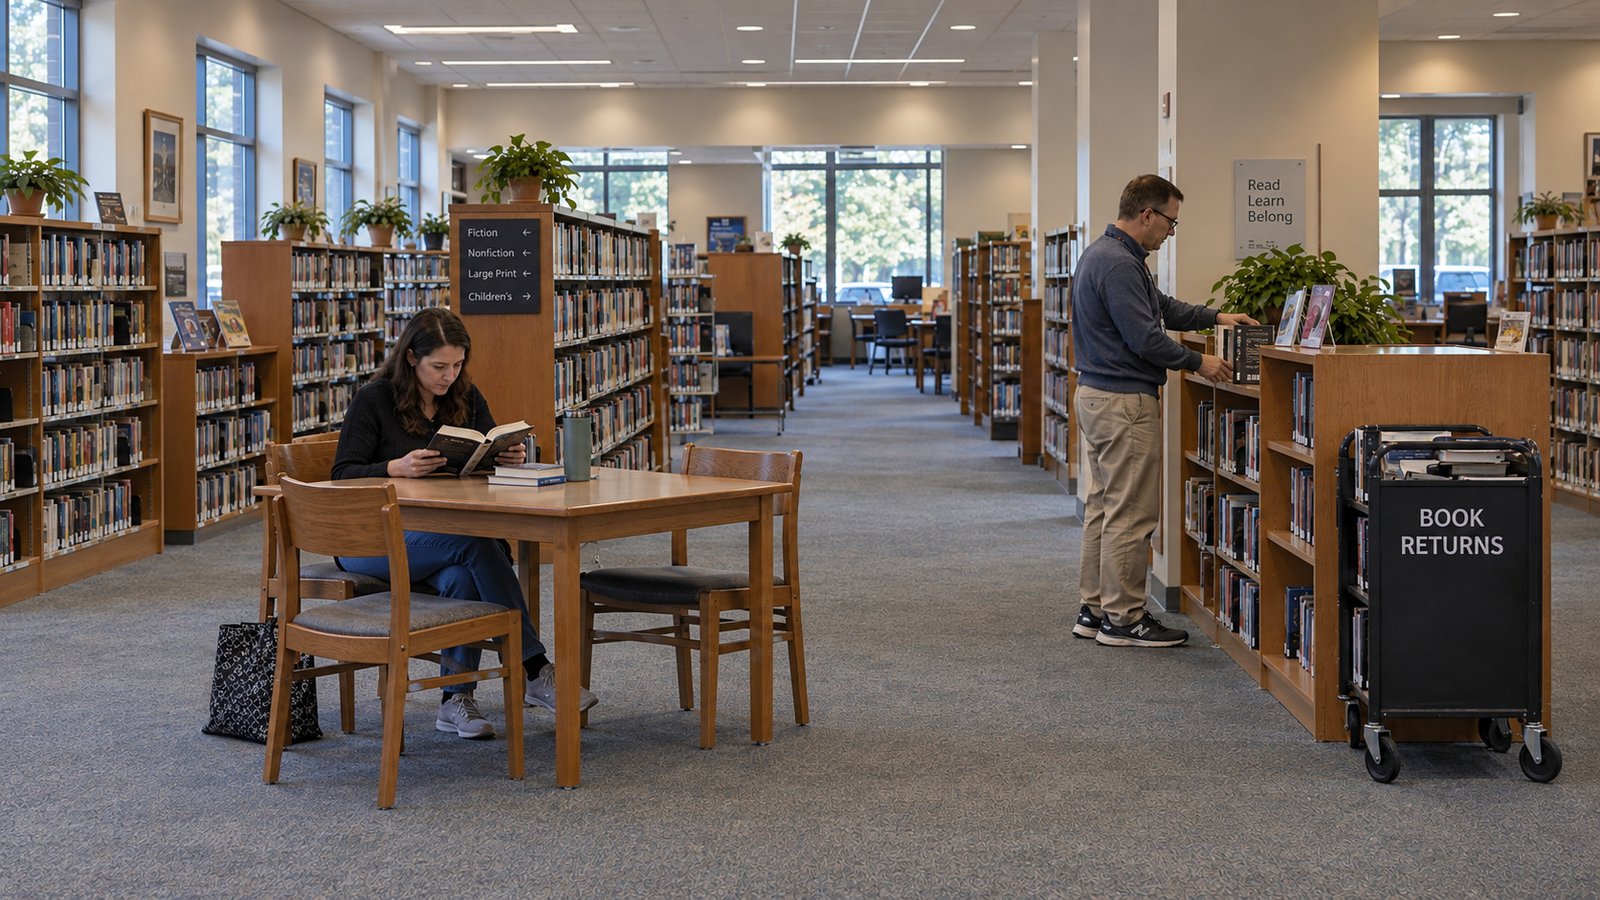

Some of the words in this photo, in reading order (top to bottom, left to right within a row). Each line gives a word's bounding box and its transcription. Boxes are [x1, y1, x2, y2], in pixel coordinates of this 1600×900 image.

[1248, 179, 1280, 191] Read
[1248, 195, 1284, 206] Learn
[1248, 210, 1293, 225] Belong
[467, 228, 498, 237] Fiction
[467, 248, 515, 257] Nonfiction
[468, 269, 493, 280] Large
[495, 269, 517, 278] Print
[468, 292, 513, 301] Children's
[1420, 508, 1485, 527] BOOK
[1401, 536, 1504, 555] RETURNS
